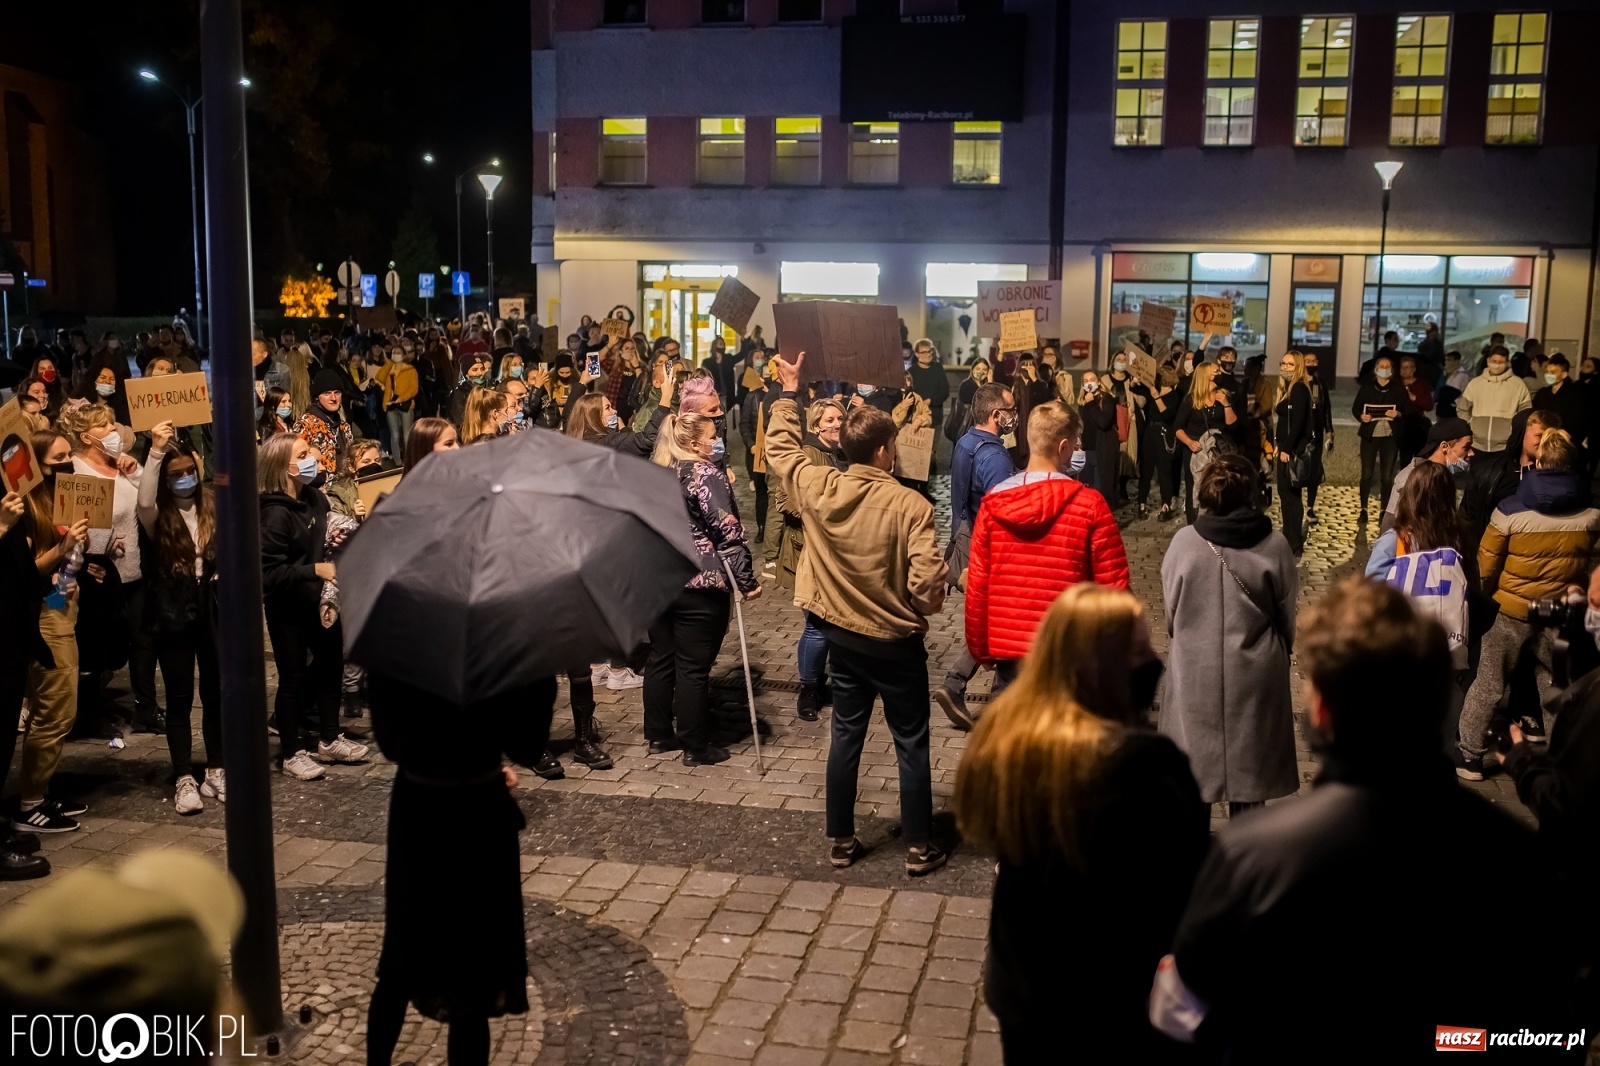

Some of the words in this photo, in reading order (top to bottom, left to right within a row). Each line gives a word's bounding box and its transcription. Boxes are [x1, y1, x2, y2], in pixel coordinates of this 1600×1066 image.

[980, 288, 990, 301] W
[997, 284, 1053, 301] OBRONIE
[981, 303, 1049, 323] WOCI
[57, 479, 92, 492] PROTEST
[75, 494, 107, 507] KOBIET
